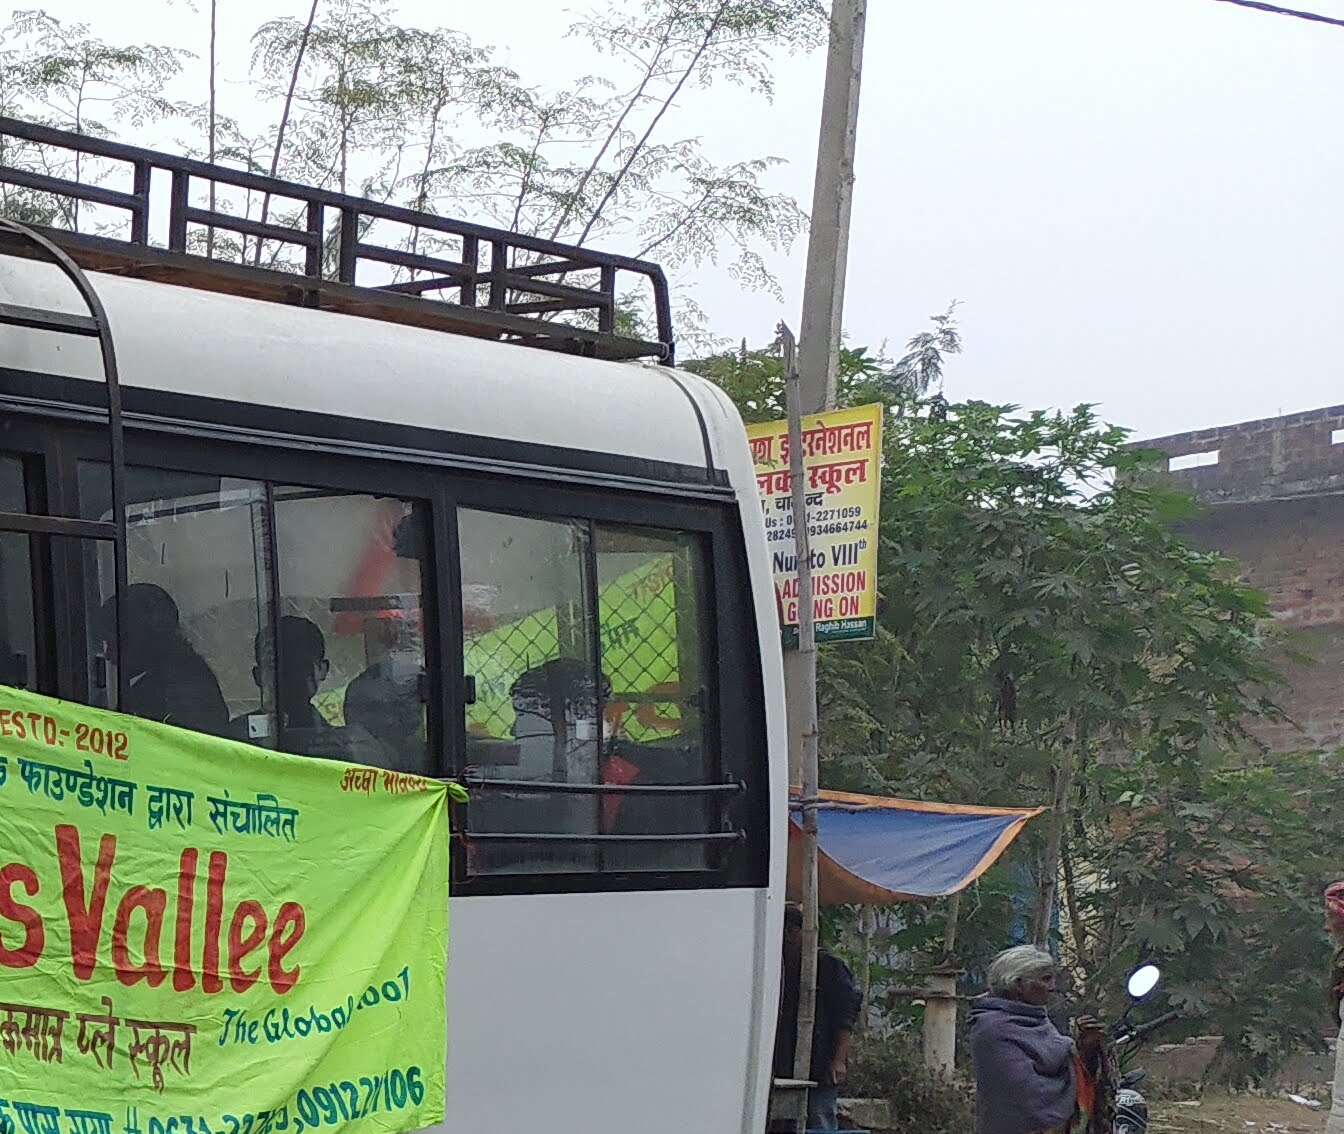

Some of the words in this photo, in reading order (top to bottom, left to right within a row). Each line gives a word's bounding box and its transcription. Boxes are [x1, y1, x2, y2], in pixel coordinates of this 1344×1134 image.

[807, 458, 869, 494] स्कूल
[787, 598, 833, 622] GNG
[839, 595, 860, 616] ON
[147, 784, 194, 831] द्वारा
[208, 789, 300, 843] संचालित
[218, 1008, 258, 1047] The
[263, 996, 355, 1042] Global
[125, 1019, 197, 1095] स्कूल
